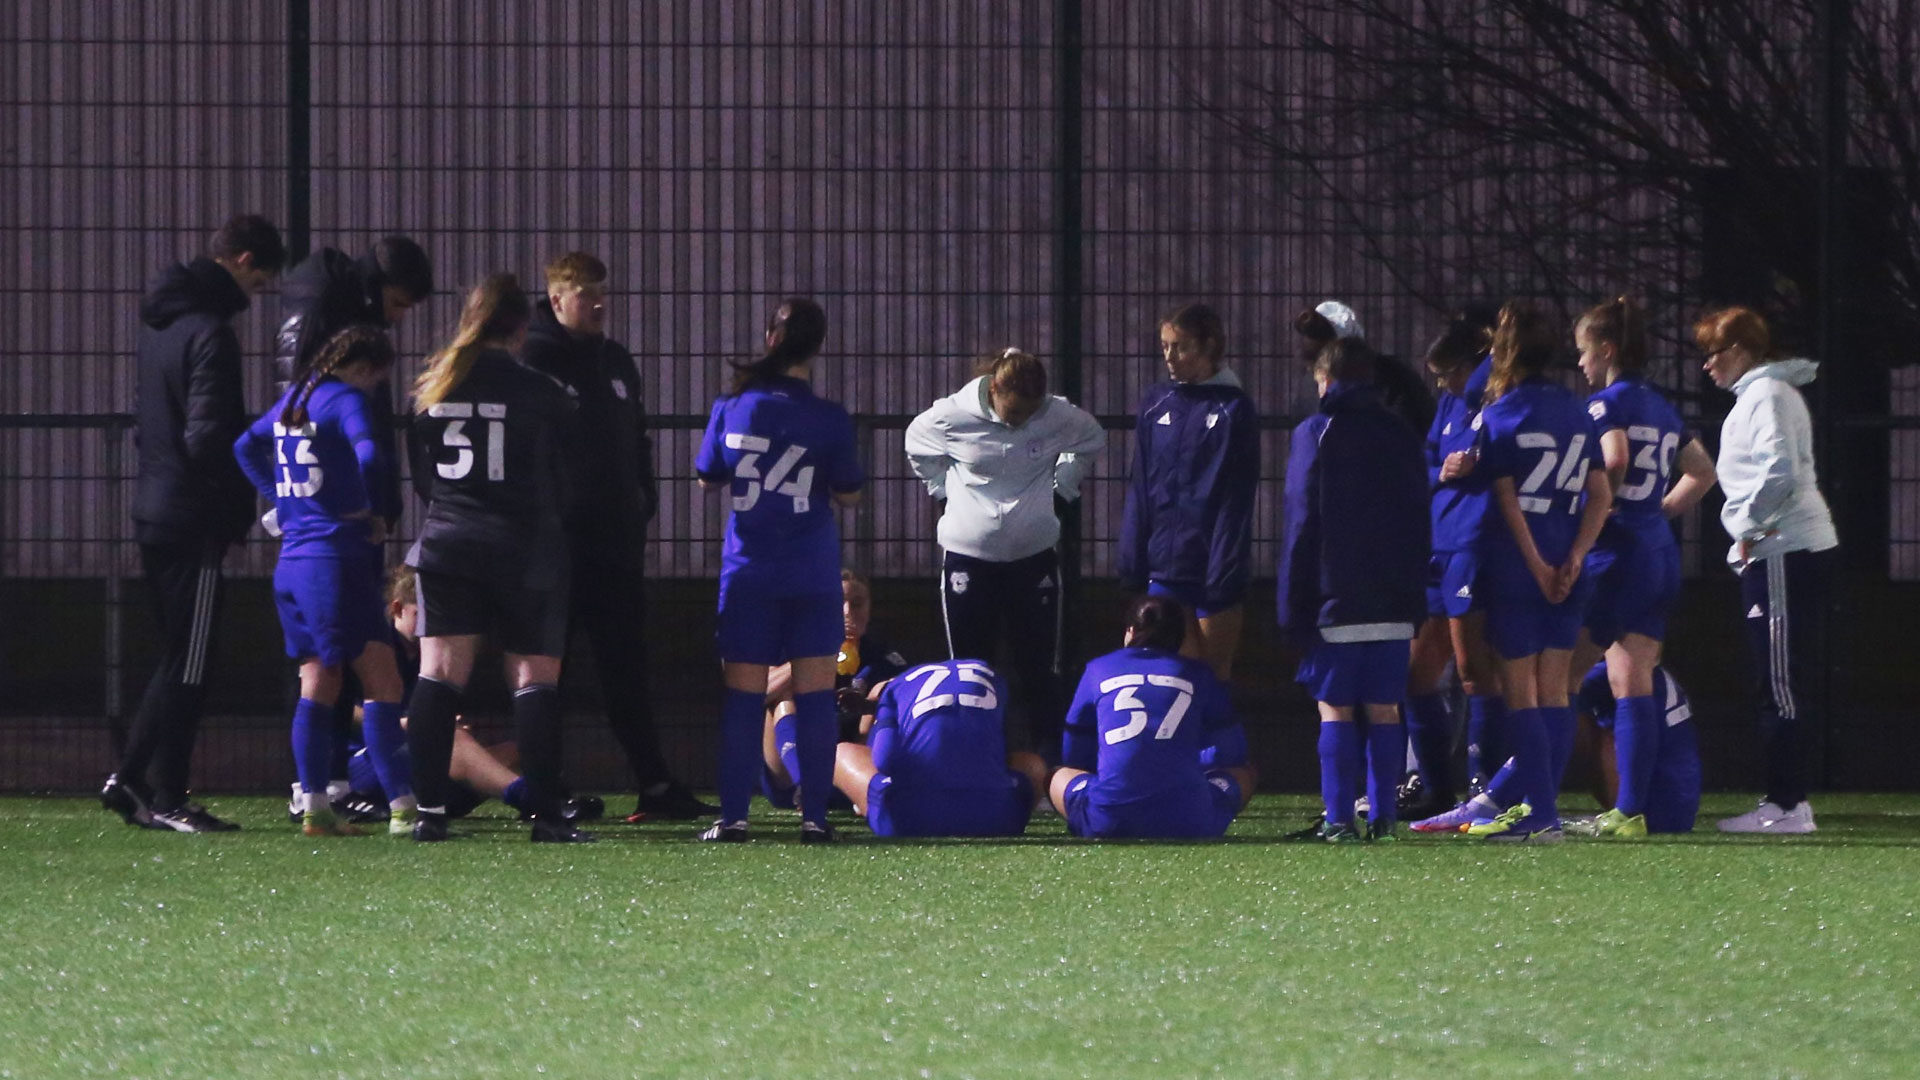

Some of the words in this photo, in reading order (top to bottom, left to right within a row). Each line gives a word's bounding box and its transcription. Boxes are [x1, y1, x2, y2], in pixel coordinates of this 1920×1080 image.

[428, 402, 507, 481] 31
[725, 433, 815, 514] 34
[1515, 432, 1591, 515] 24
[905, 663, 998, 719] 25
[1099, 674, 1194, 745] 37
